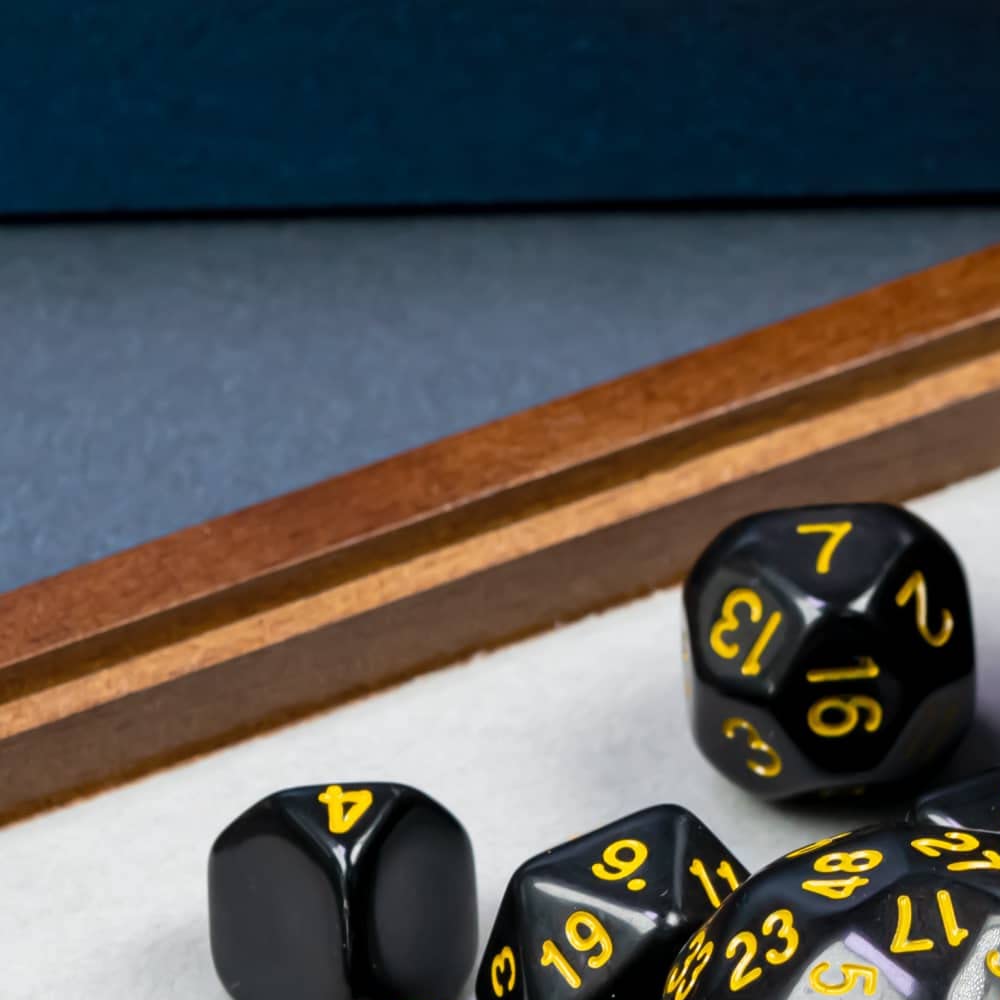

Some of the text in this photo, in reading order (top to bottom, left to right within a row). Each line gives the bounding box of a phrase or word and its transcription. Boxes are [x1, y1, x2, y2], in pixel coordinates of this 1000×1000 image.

[795, 520, 853, 575] 7
[709, 587, 783, 677] 13
[896, 572, 954, 647] 2
[807, 655, 883, 737] 16
[723, 718, 782, 777] 3
[317, 784, 374, 834] 4
[801, 848, 884, 900] 48
[539, 909, 615, 989] 19
[724, 908, 800, 992] 23
[889, 888, 970, 955] 17
[491, 946, 516, 997] 3
